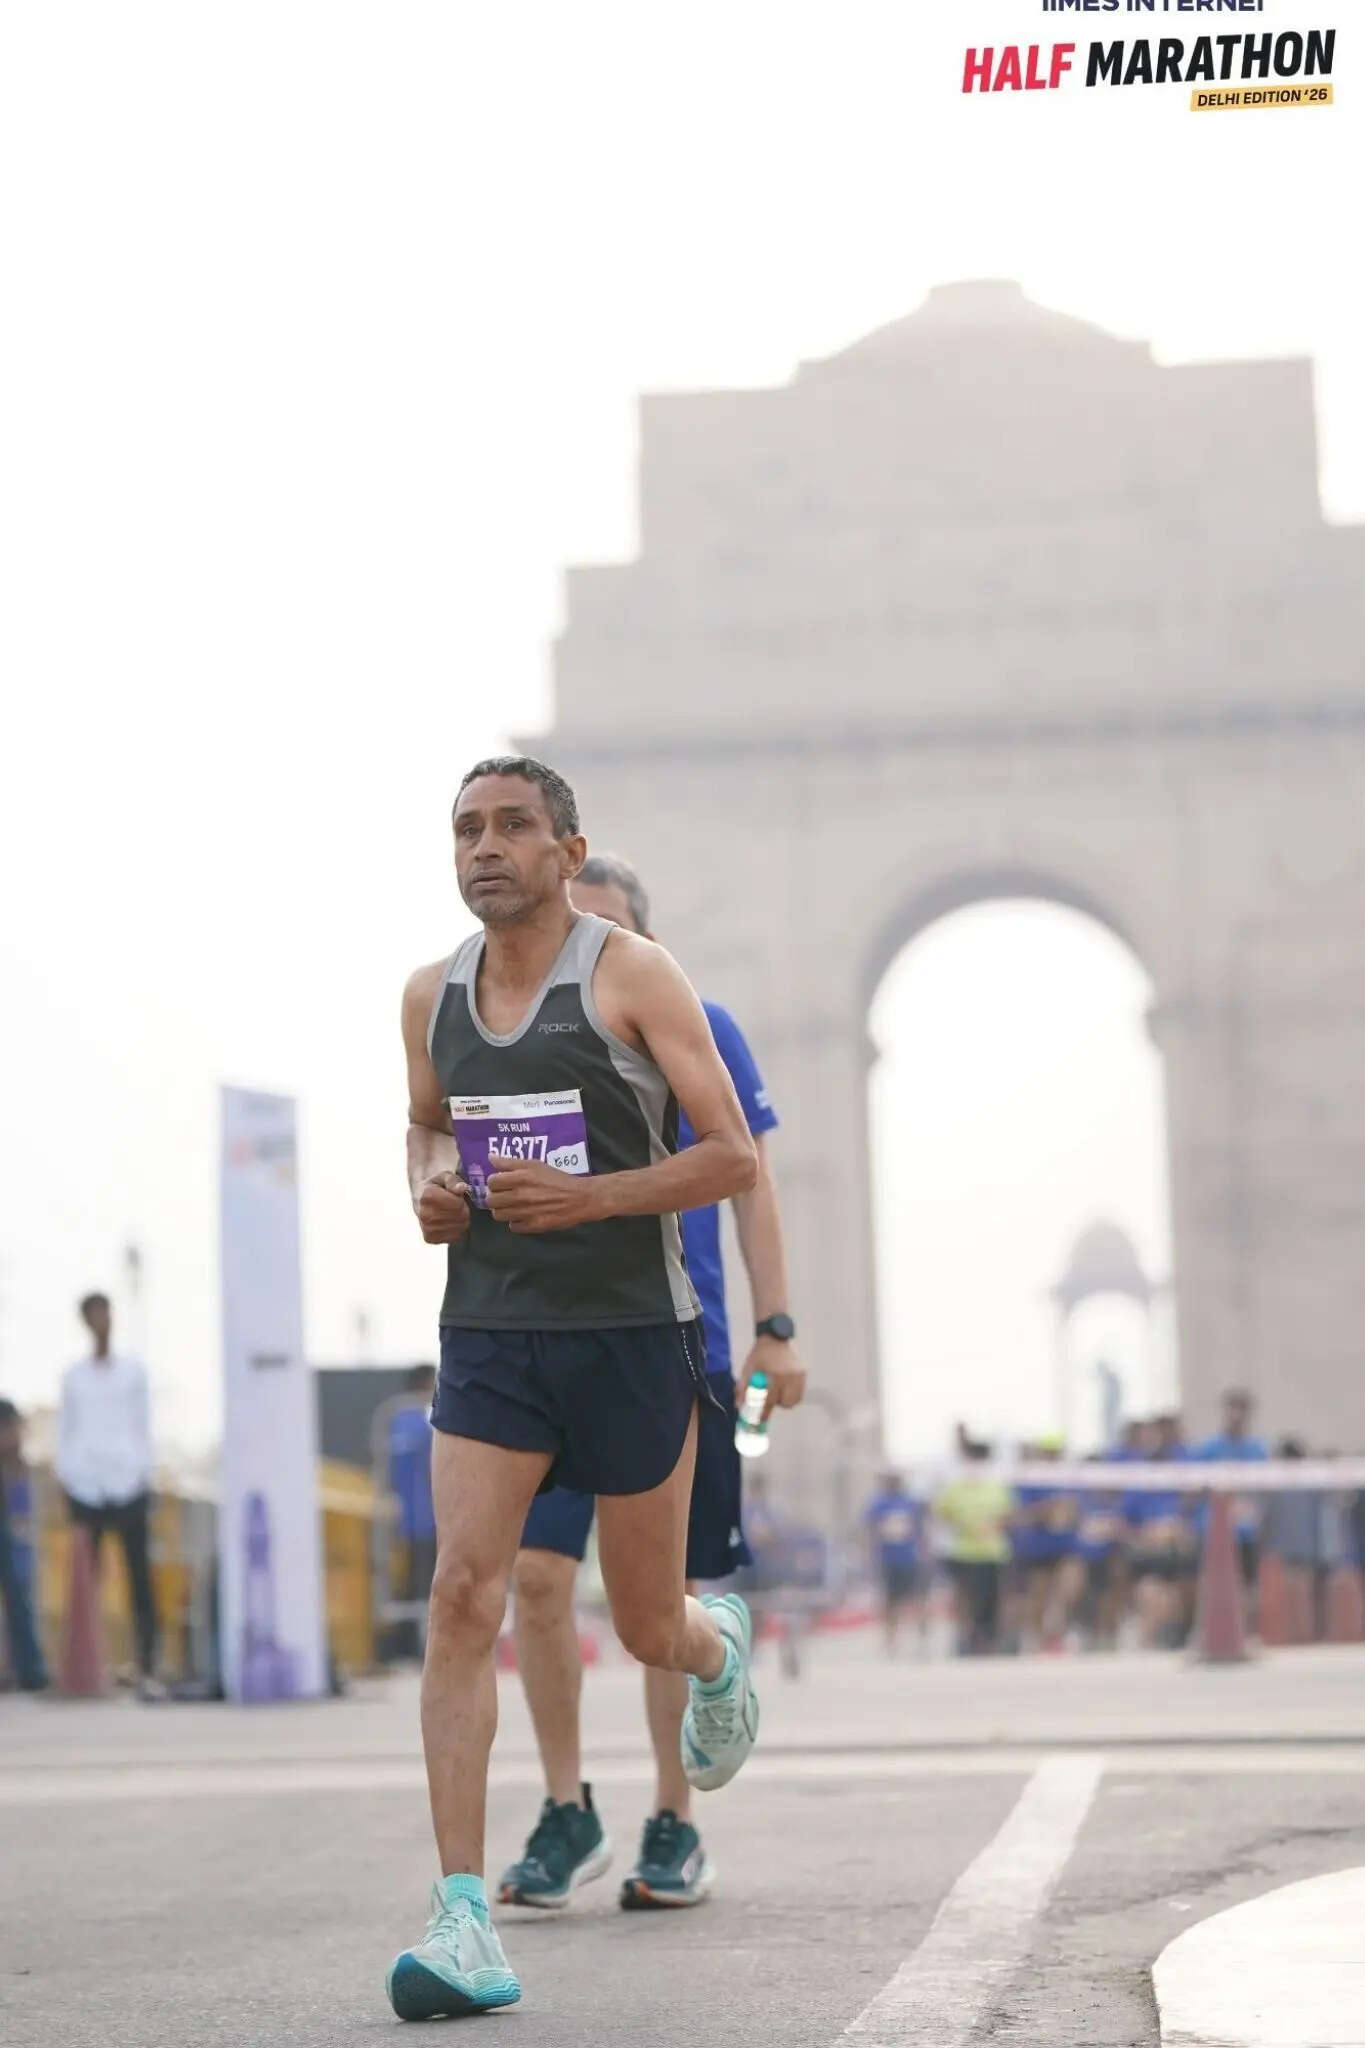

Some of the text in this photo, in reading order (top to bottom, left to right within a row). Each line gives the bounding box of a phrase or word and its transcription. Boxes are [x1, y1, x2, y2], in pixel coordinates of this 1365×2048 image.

[538, 1023, 580, 1034] ROCK
[498, 1122, 531, 1133] 5K RUN
[488, 1135, 548, 1162] 54377
